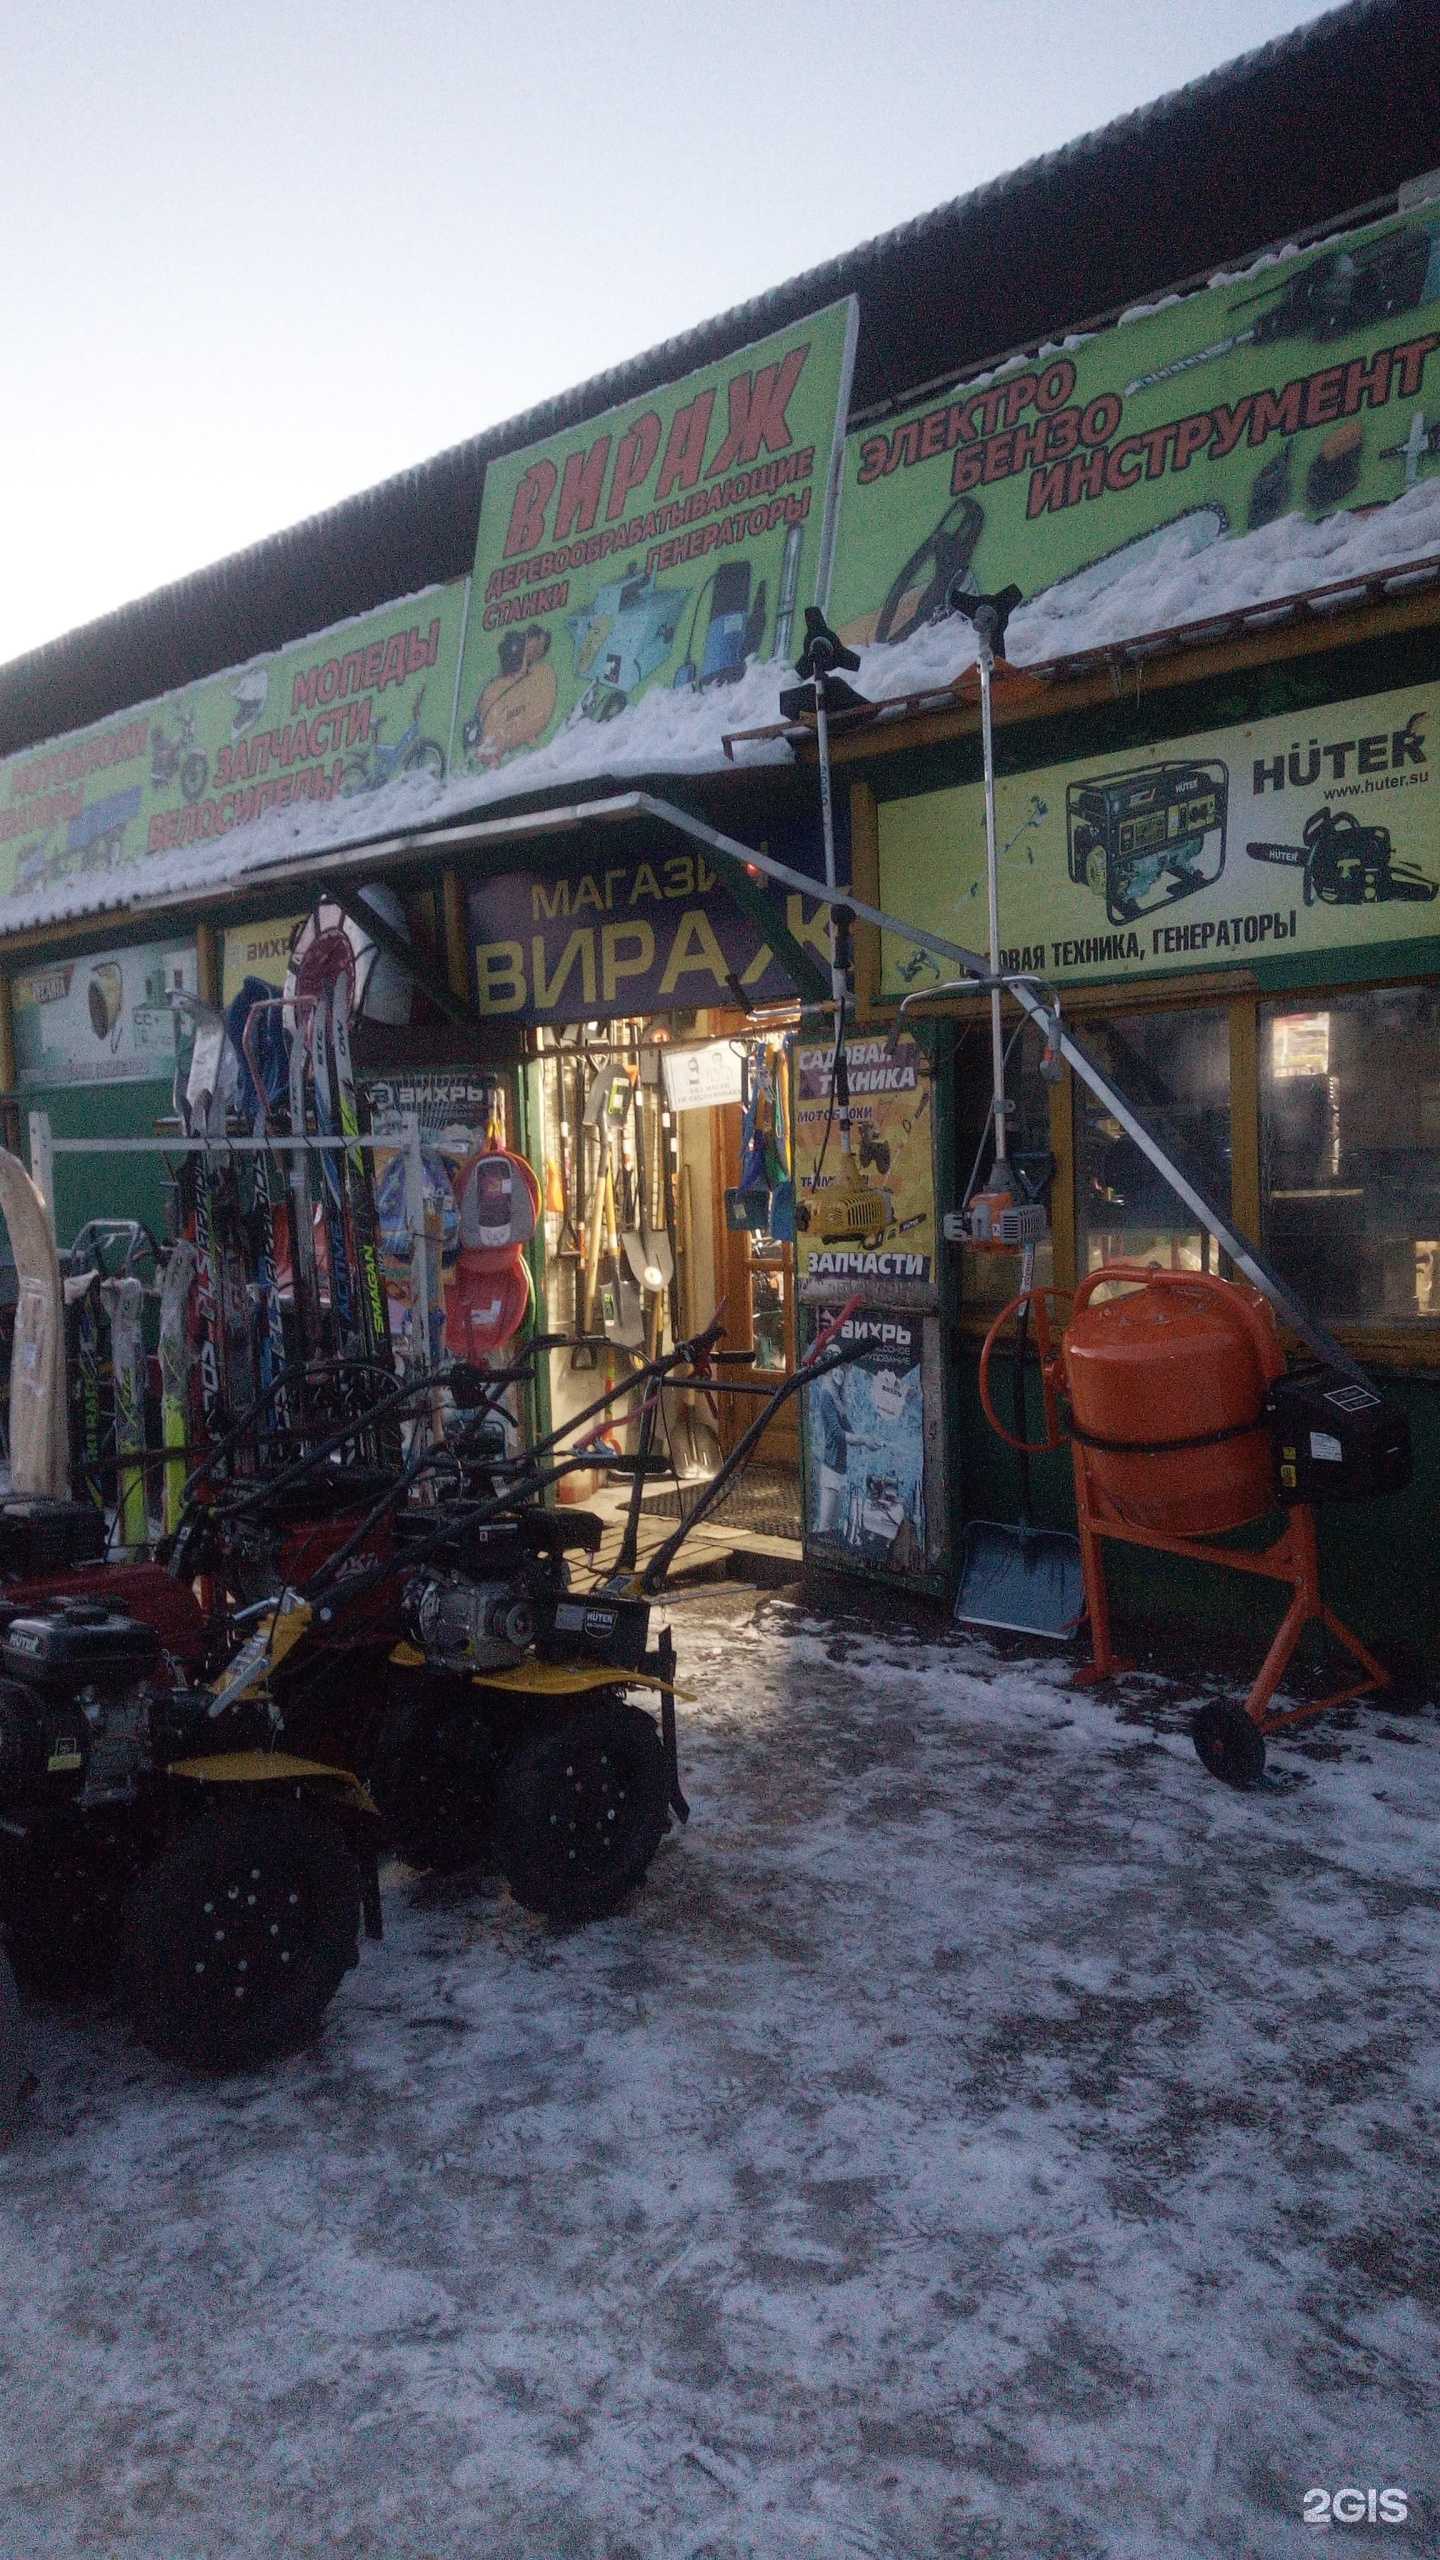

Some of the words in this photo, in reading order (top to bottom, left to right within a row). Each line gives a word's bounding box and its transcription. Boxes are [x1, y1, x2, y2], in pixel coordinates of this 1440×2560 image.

[502, 342, 810, 558] ВИРАЖ
[857, 357, 1077, 485] ЭЛЕКТРО
[950, 392, 1123, 496] БЕНЗО
[1025, 333, 1439, 520] ИНСТРУМЕНТ
[484, 446, 816, 602] ДЕРЕВООБРАБАТЫВАЮЩИЕ
[645, 487, 812, 577] ГЕНЕРАТОРЫ
[482, 579, 569, 631] СТАНКИ
[290, 618, 441, 716] МОПЕДЫ
[213, 697, 374, 790] ЗАПЧАСТИ
[1252, 722, 1428, 796] HÜTER
[1323, 770, 1429, 801] www.huter.su
[1052, 931, 1145, 968] ТЕХНИКА,
[1152, 910, 1296, 955] ГЕНЕРАТОРЫ
[798, 1106, 873, 1122] МОТОБОКИ
[819, 1066, 916, 1096] ТХНИКА
[807, 1252, 924, 1276] ЗАПЧАСТИ
